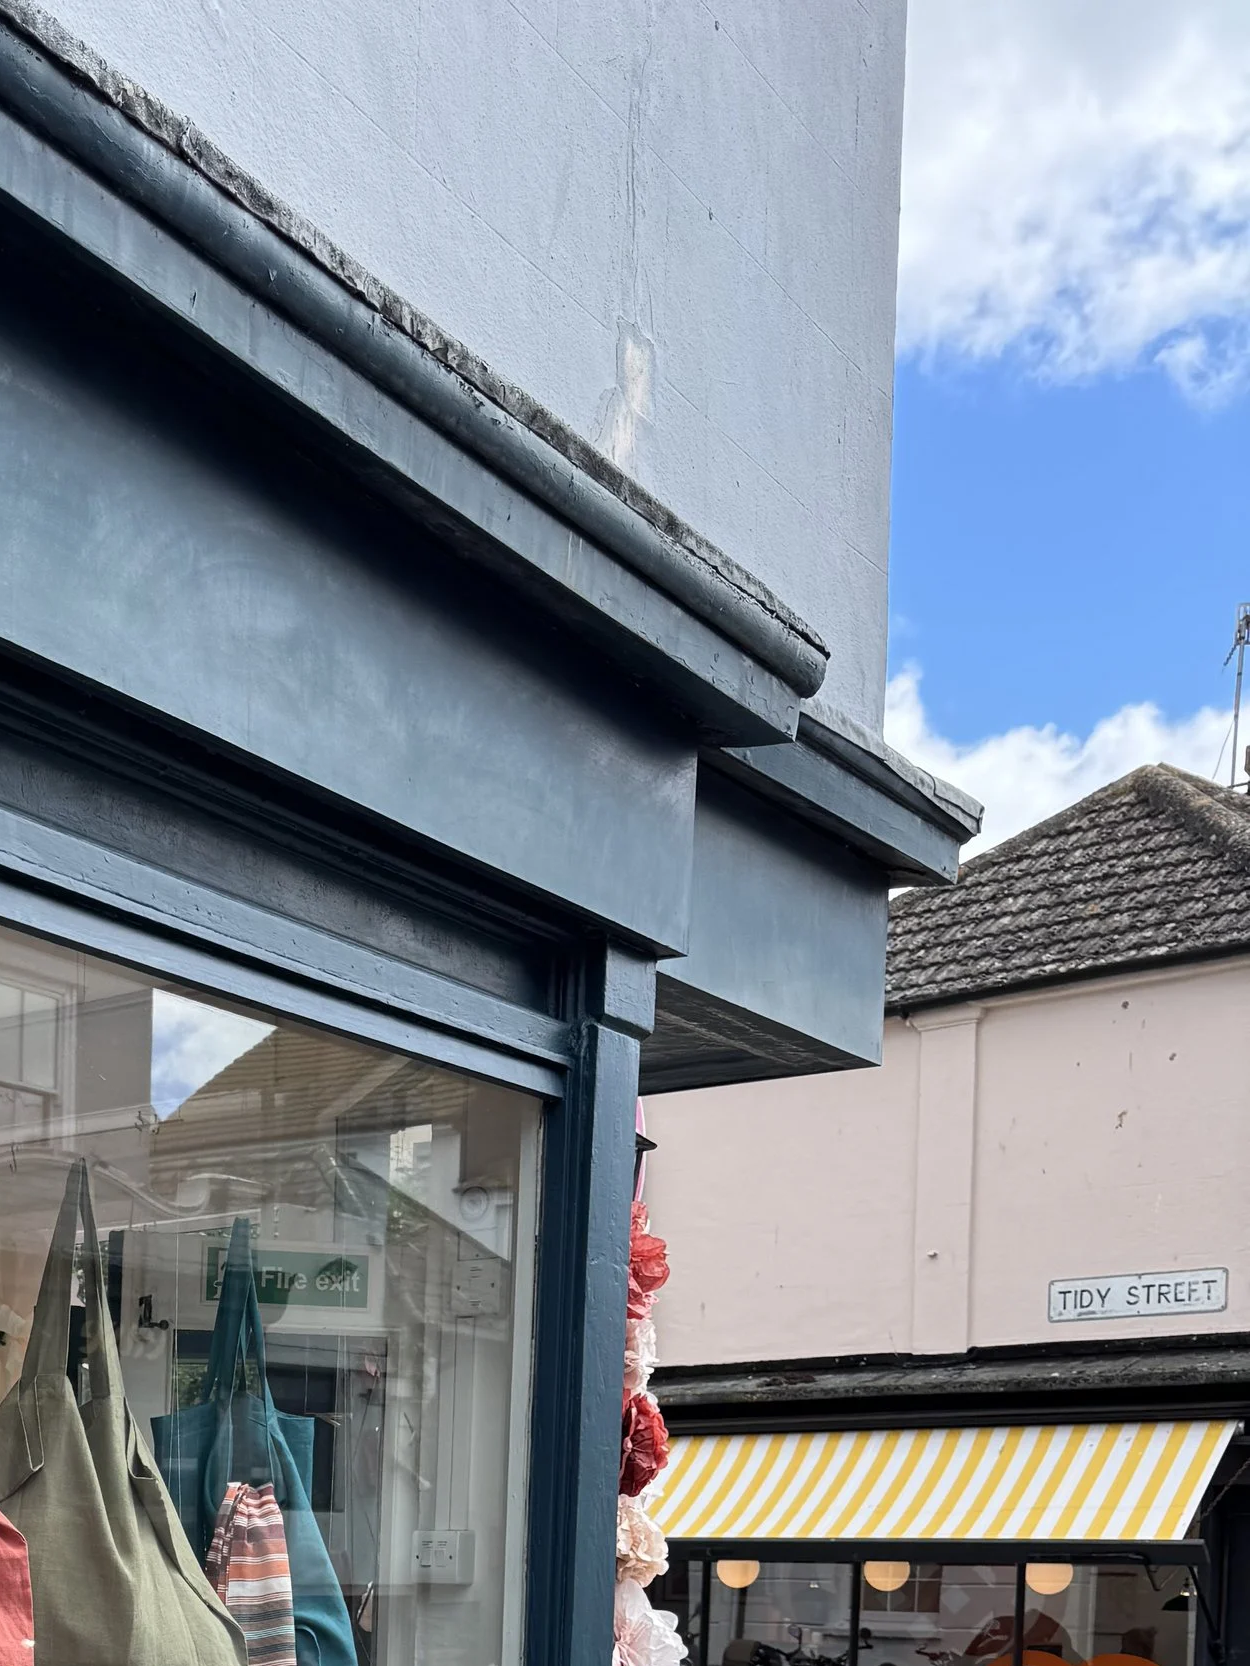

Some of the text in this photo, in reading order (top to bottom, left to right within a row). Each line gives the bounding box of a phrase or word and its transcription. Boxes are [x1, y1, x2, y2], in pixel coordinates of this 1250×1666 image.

[260, 1266, 360, 1293] Fire exit
[1058, 1279, 1218, 1310] TIDY STREET
